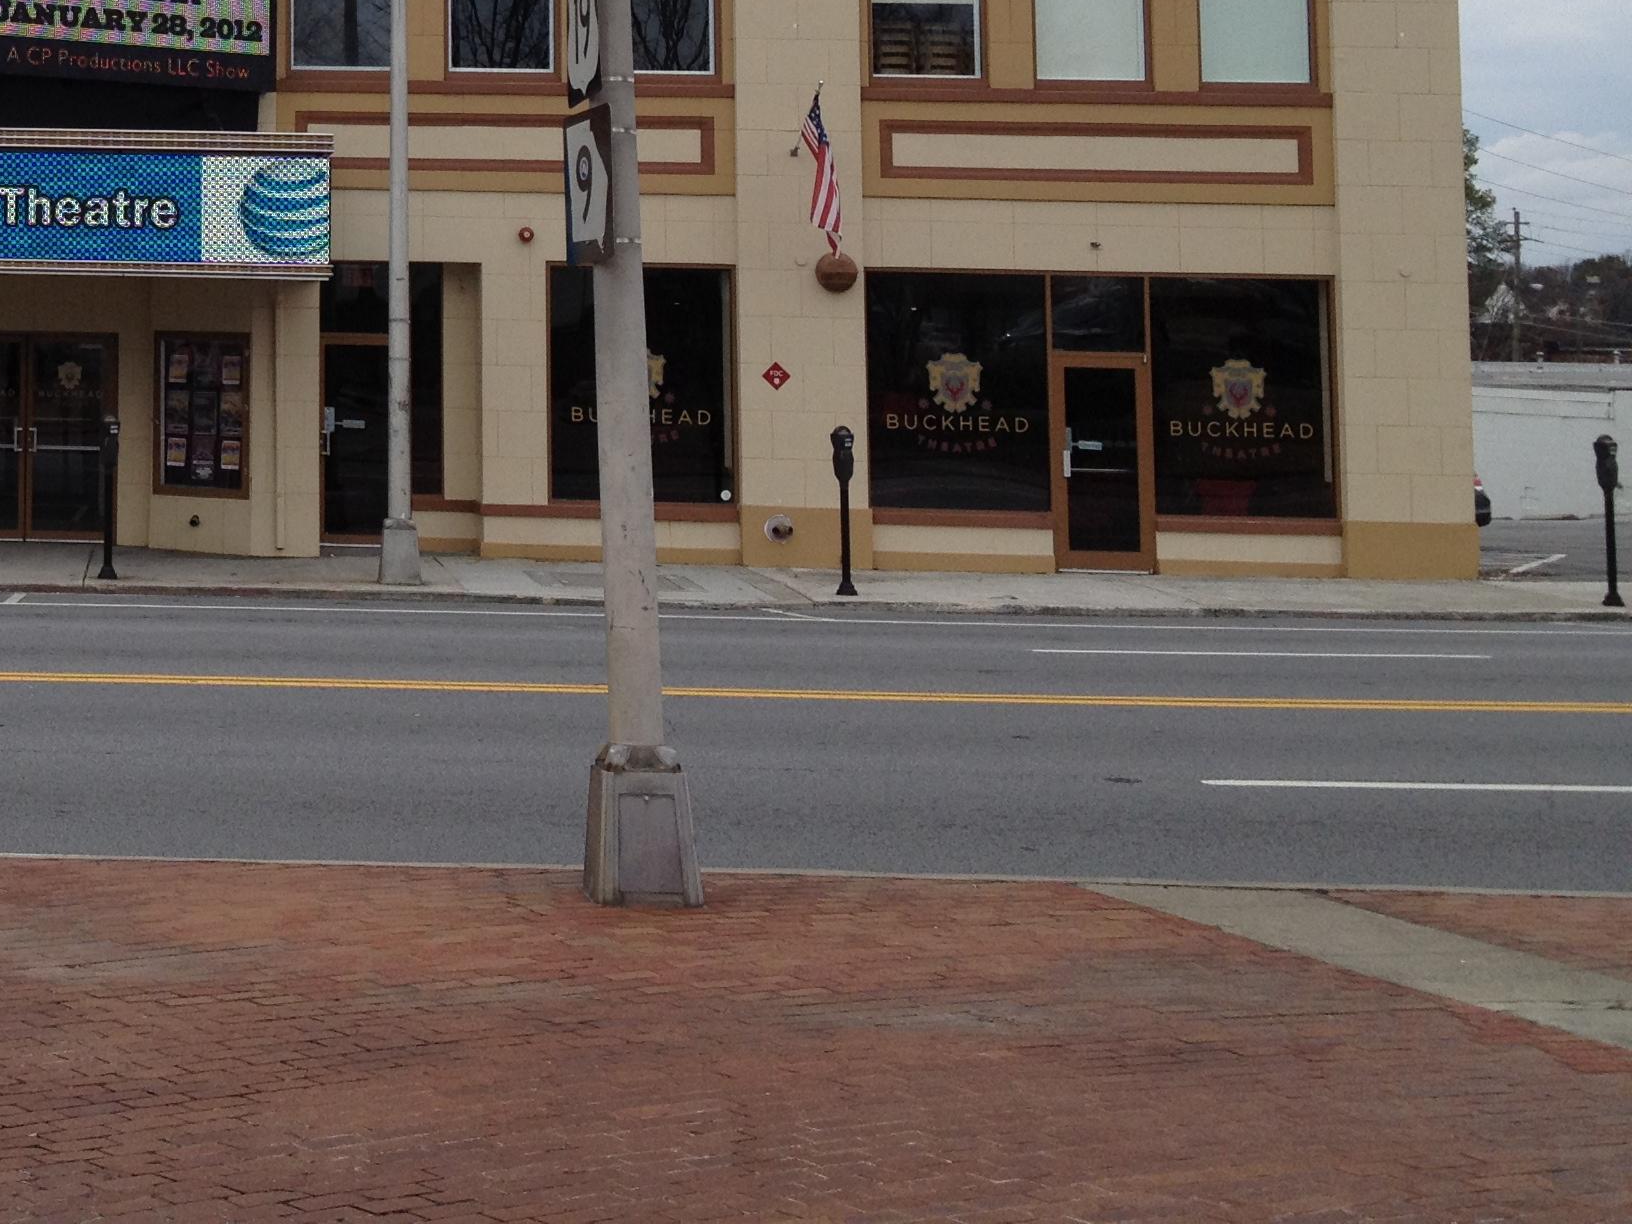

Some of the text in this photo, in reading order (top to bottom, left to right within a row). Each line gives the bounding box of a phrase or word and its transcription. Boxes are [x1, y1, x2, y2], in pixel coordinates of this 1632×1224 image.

[151, 13, 194, 42] 28,
[199, 17, 263, 42] 2012
[7, 47, 250, 79] A CP Productions LLC Show
[576, 144, 592, 224] 9
[885, 413, 1030, 434] BUCKHEAD
[1169, 419, 1315, 440] BUCKHEAD
